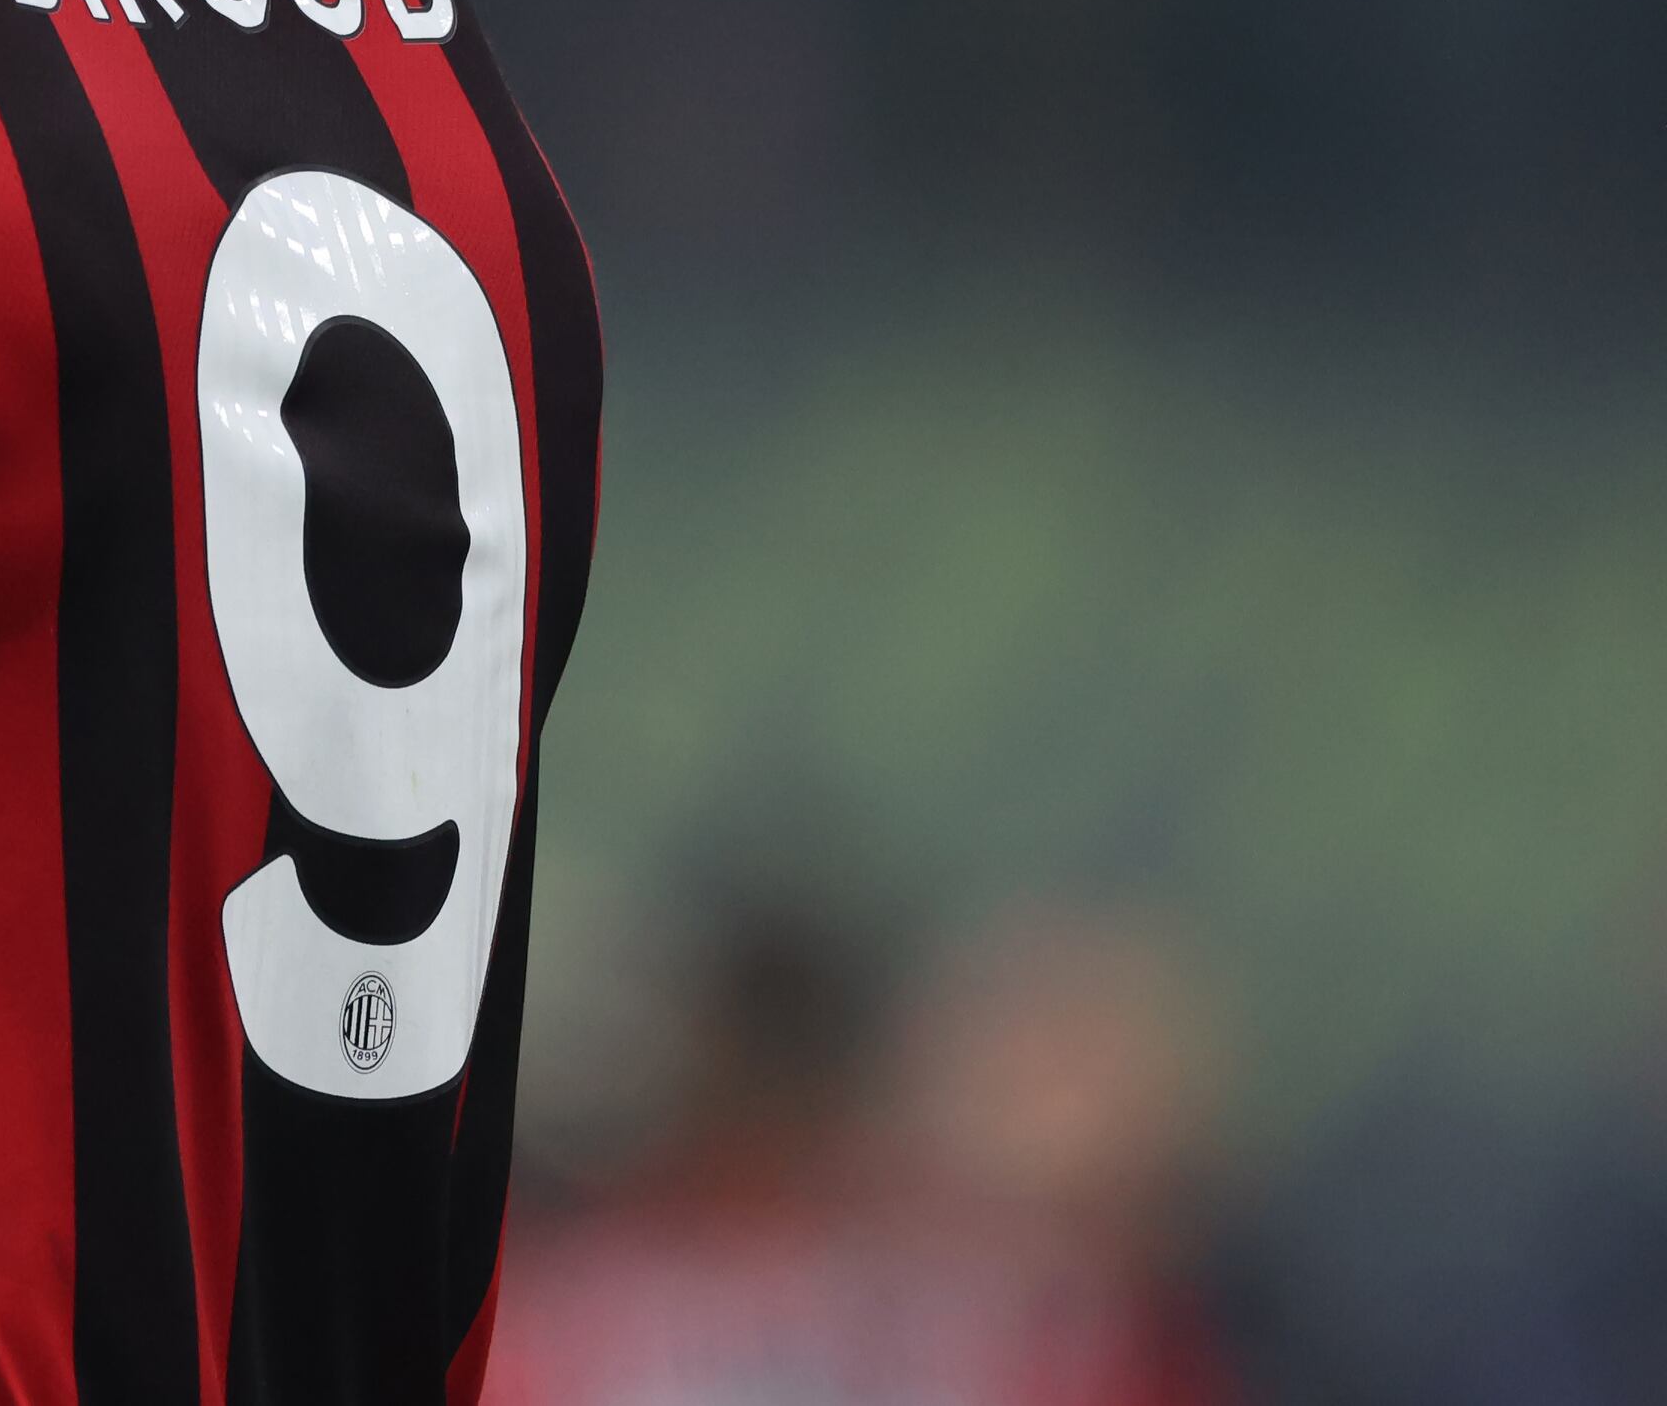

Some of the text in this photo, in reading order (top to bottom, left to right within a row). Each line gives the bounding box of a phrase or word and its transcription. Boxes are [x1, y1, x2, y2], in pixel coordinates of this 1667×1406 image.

[197, 170, 527, 1100] 9
[354, 979, 386, 999] ACM
[352, 1049, 379, 1062] 1899
